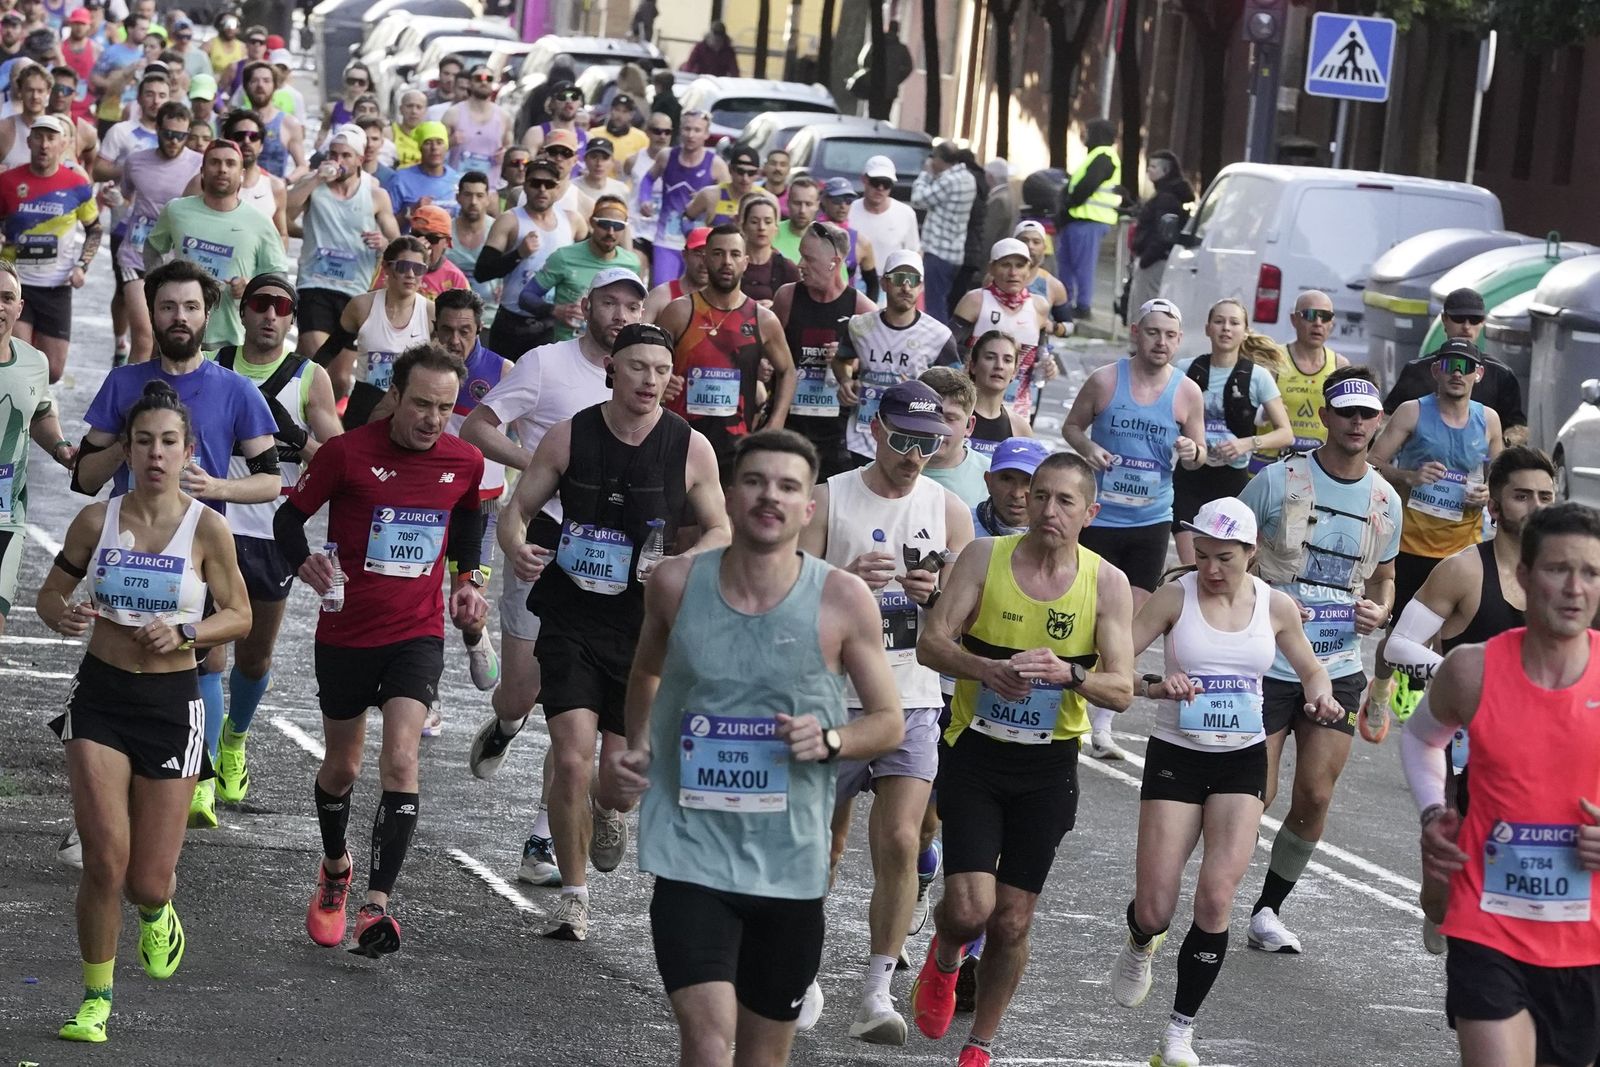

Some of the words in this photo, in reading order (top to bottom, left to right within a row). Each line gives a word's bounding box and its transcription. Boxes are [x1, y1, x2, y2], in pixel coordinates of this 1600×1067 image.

[200, 242, 228, 254] ZURICH
[801, 346, 831, 357] TREVO
[704, 370, 735, 379] ZURICH
[1343, 381, 1369, 394] OTSO
[694, 393, 732, 405] JULIETA
[797, 394, 833, 405] TREVOR
[1110, 415, 1168, 437] Lothian
[1109, 428, 1145, 441] Running
[1145, 434, 1165, 446] Club
[974, 442, 998, 452] ZURIC
[1125, 458, 1156, 470] ZURICH
[1123, 472, 1142, 483] 6305
[1112, 481, 1150, 496] SHAUN
[1411, 489, 1437, 504] DAVID
[1437, 498, 1465, 511] ARCAS
[399, 511, 440, 523] ZURICH
[397, 531, 420, 542] 7097
[587, 529, 626, 542] ZURICH
[389, 544, 424, 560] YAYO
[584, 547, 606, 559] 7230
[125, 555, 175, 569] ZURICH
[571, 559, 613, 578] JAMIE
[123, 576, 150, 589] 6778
[137, 597, 178, 610] RUEDA
[1002, 611, 1024, 623] GOBIK
[1319, 608, 1350, 620] ZURICH
[1319, 628, 1339, 638] 8097
[1313, 638, 1344, 654] OBIAS
[1208, 679, 1251, 690] ZURICH
[1210, 700, 1234, 710] 8614
[990, 703, 1041, 726] SALAS
[1203, 712, 1240, 729] MILA
[716, 722, 776, 736] ZURICH
[717, 750, 749, 764] 9376
[697, 767, 769, 789] MAXOU
[1519, 827, 1580, 842] ZURICH
[1520, 857, 1553, 870] 6784
[1505, 873, 1569, 896] PABLO
